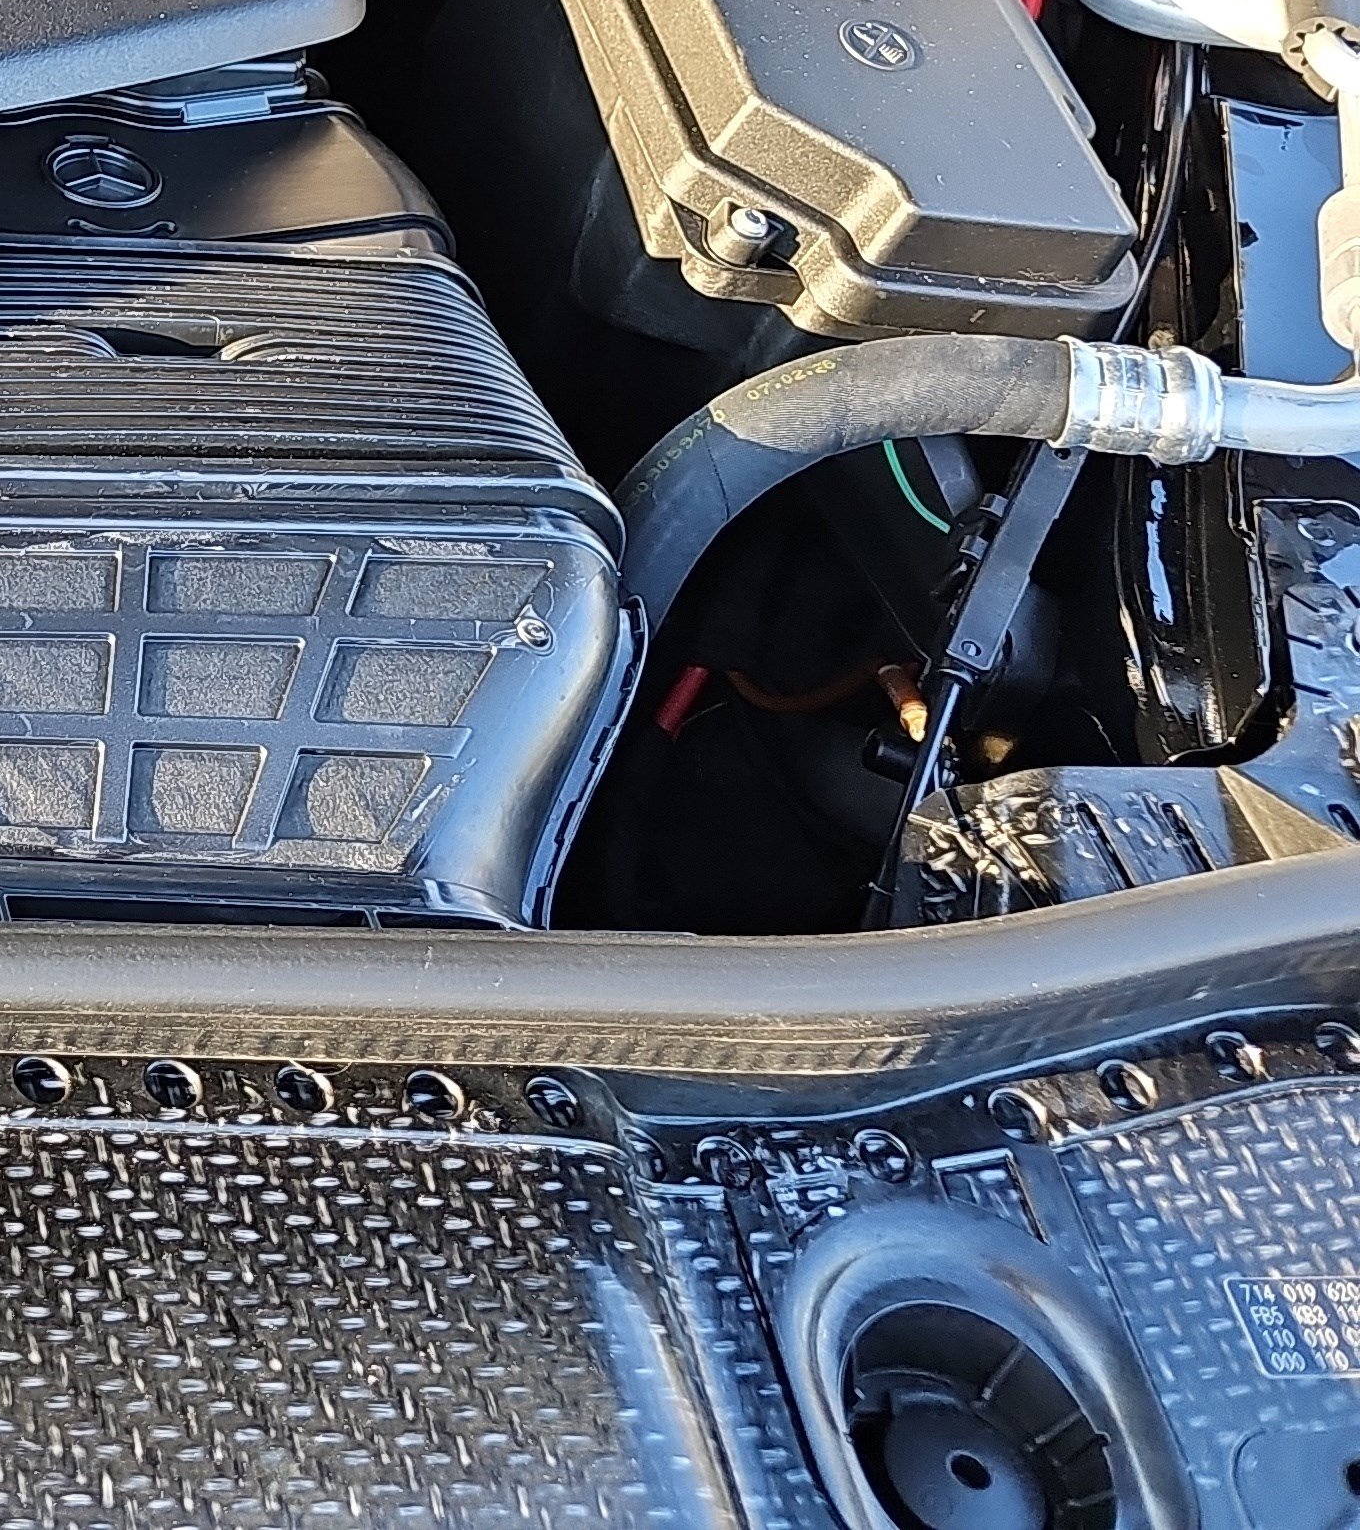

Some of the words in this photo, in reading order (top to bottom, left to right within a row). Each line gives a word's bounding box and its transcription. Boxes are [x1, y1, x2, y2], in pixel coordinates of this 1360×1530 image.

[1239, 1283, 1277, 1305] 714
[1283, 1283, 1317, 1304] 019
[1262, 1329, 1296, 1348] 110
[1304, 1327, 1339, 1348] 010
